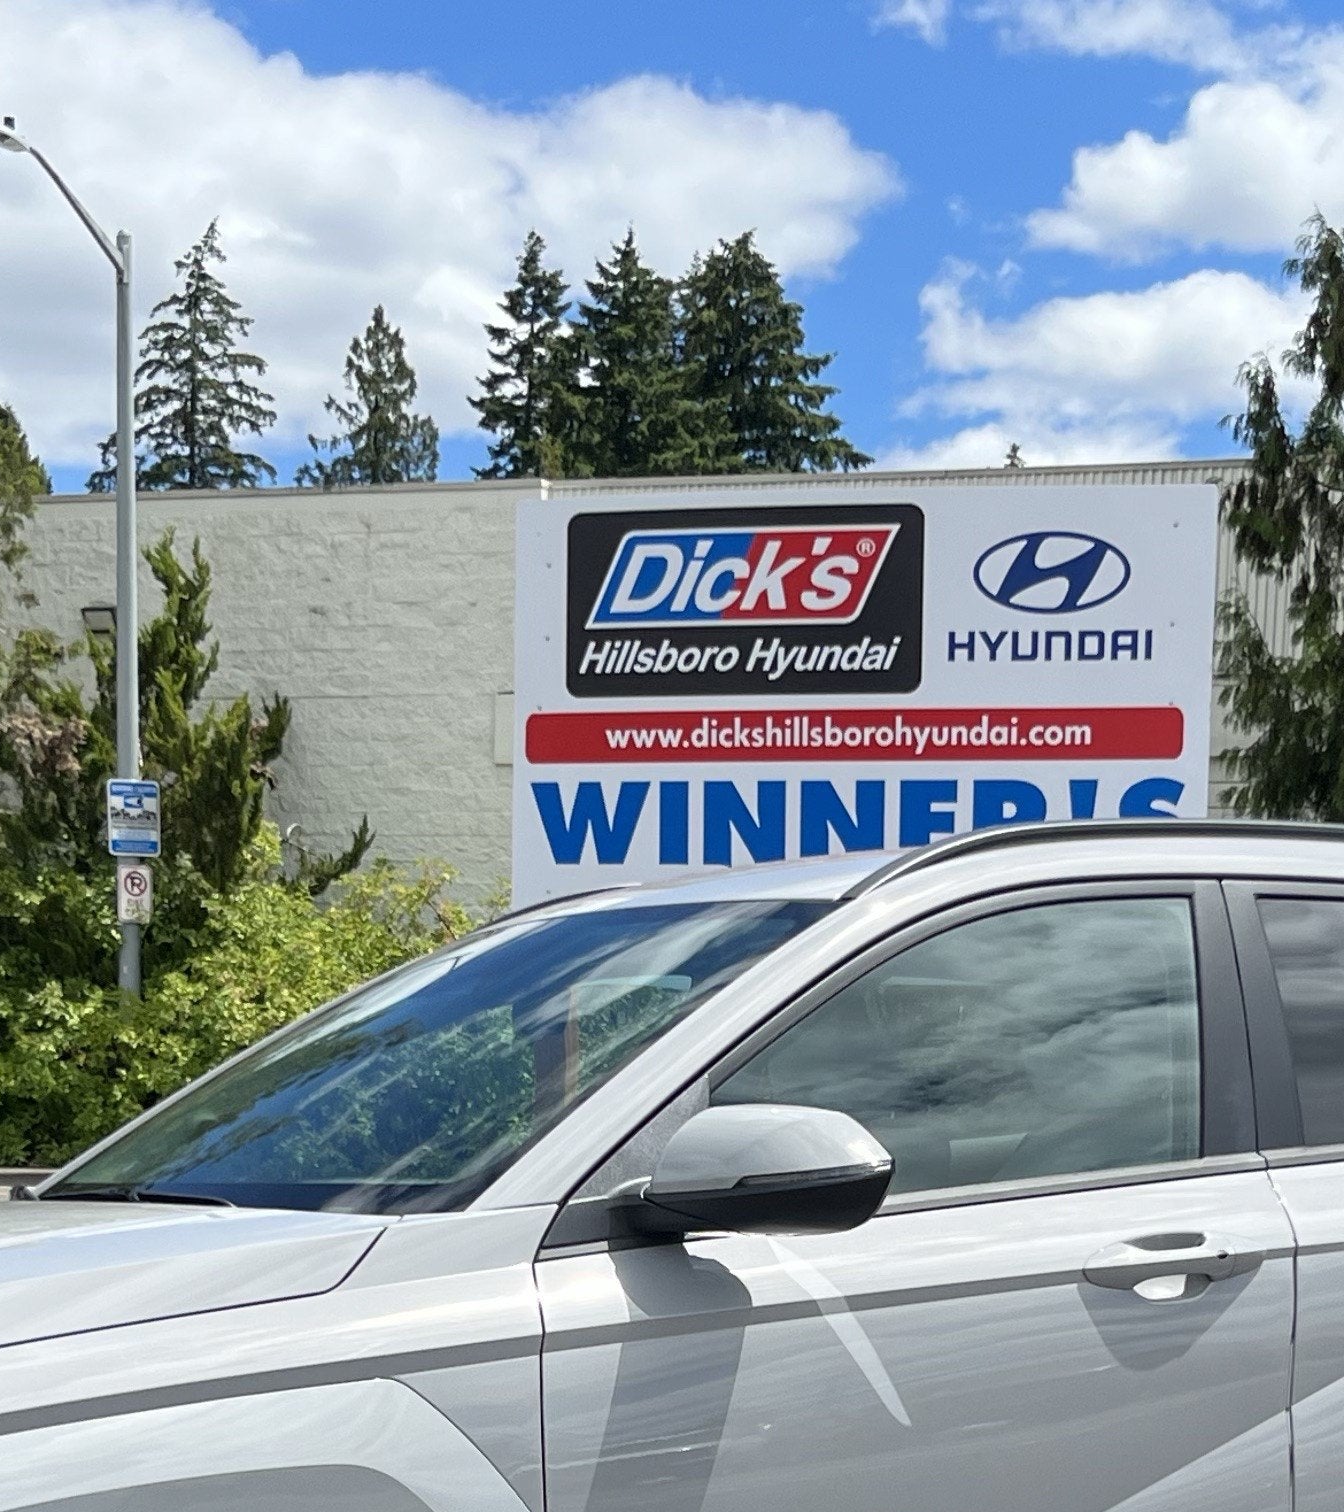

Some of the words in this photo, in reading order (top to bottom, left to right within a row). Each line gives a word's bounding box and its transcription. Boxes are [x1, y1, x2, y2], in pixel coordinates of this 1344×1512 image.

[609, 536, 859, 614] Dick's
[579, 639, 740, 675] Hillsboro
[745, 636, 902, 682] Hyundai
[947, 629, 1153, 662] HYUNDAI
[605, 714, 1092, 755] www.dickshillsborohyundai.com
